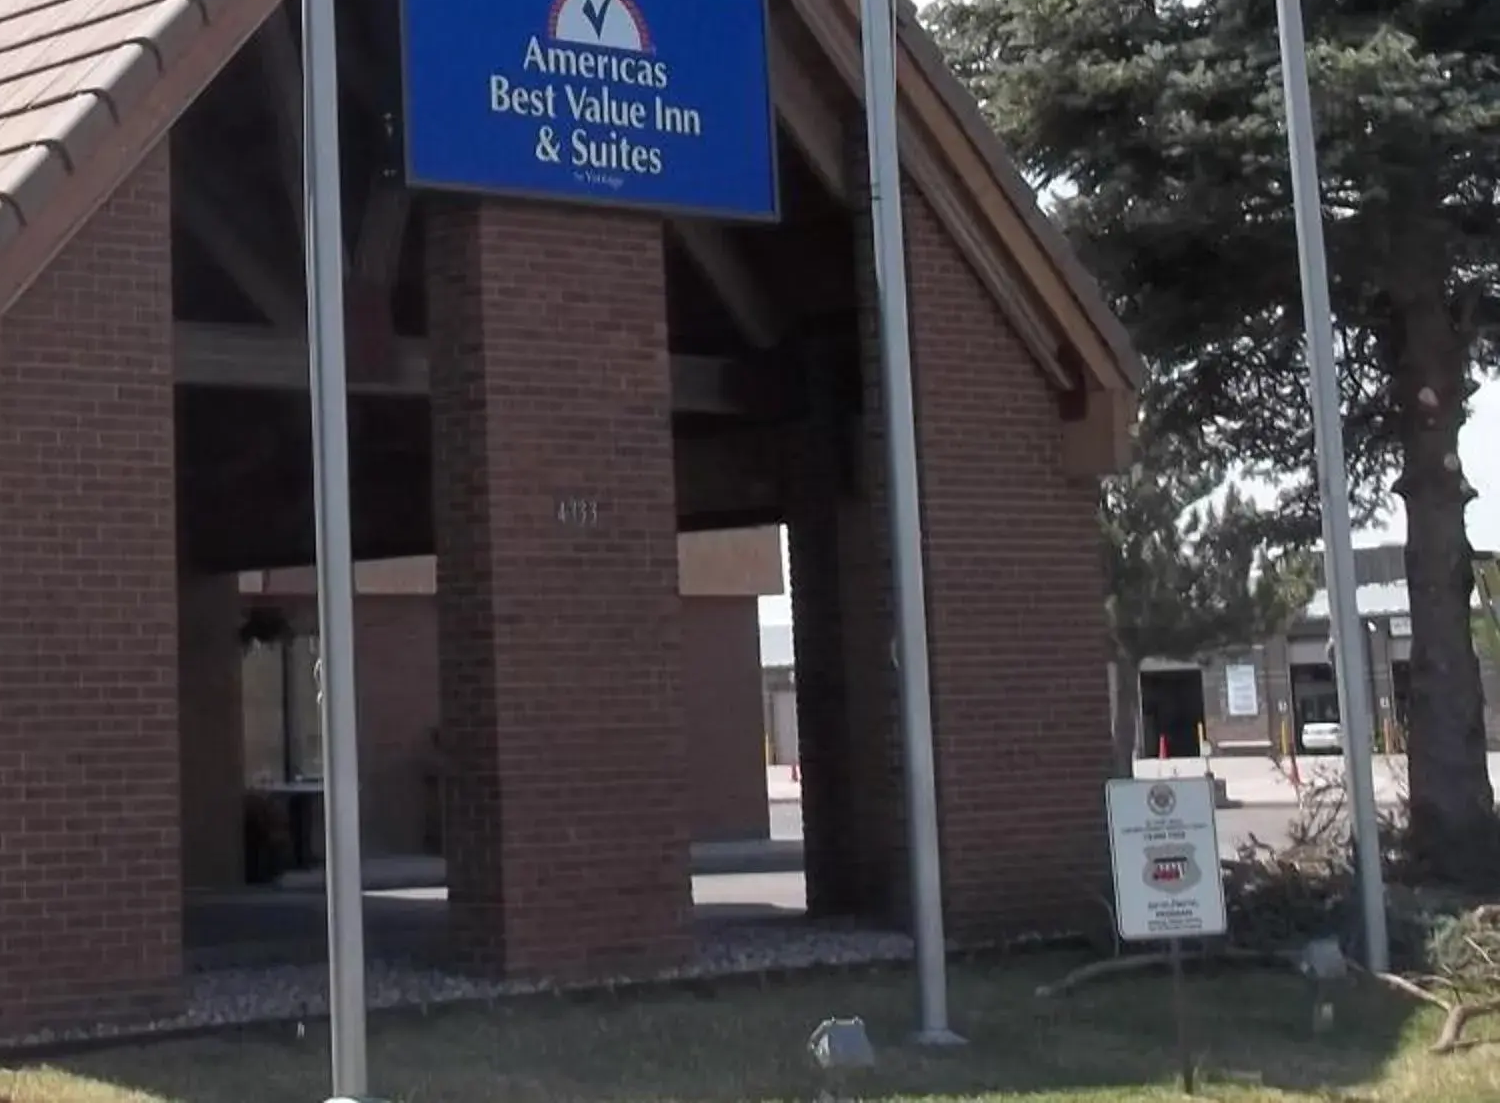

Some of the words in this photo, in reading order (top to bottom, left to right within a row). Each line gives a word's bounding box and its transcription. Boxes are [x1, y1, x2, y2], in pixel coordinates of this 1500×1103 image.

[523, 35, 668, 89] Americas
[490, 75, 556, 118] Best
[565, 84, 646, 128] Value
[655, 96, 700, 136] Inn
[535, 126, 561, 163] &
[571, 129, 662, 174] Suites
